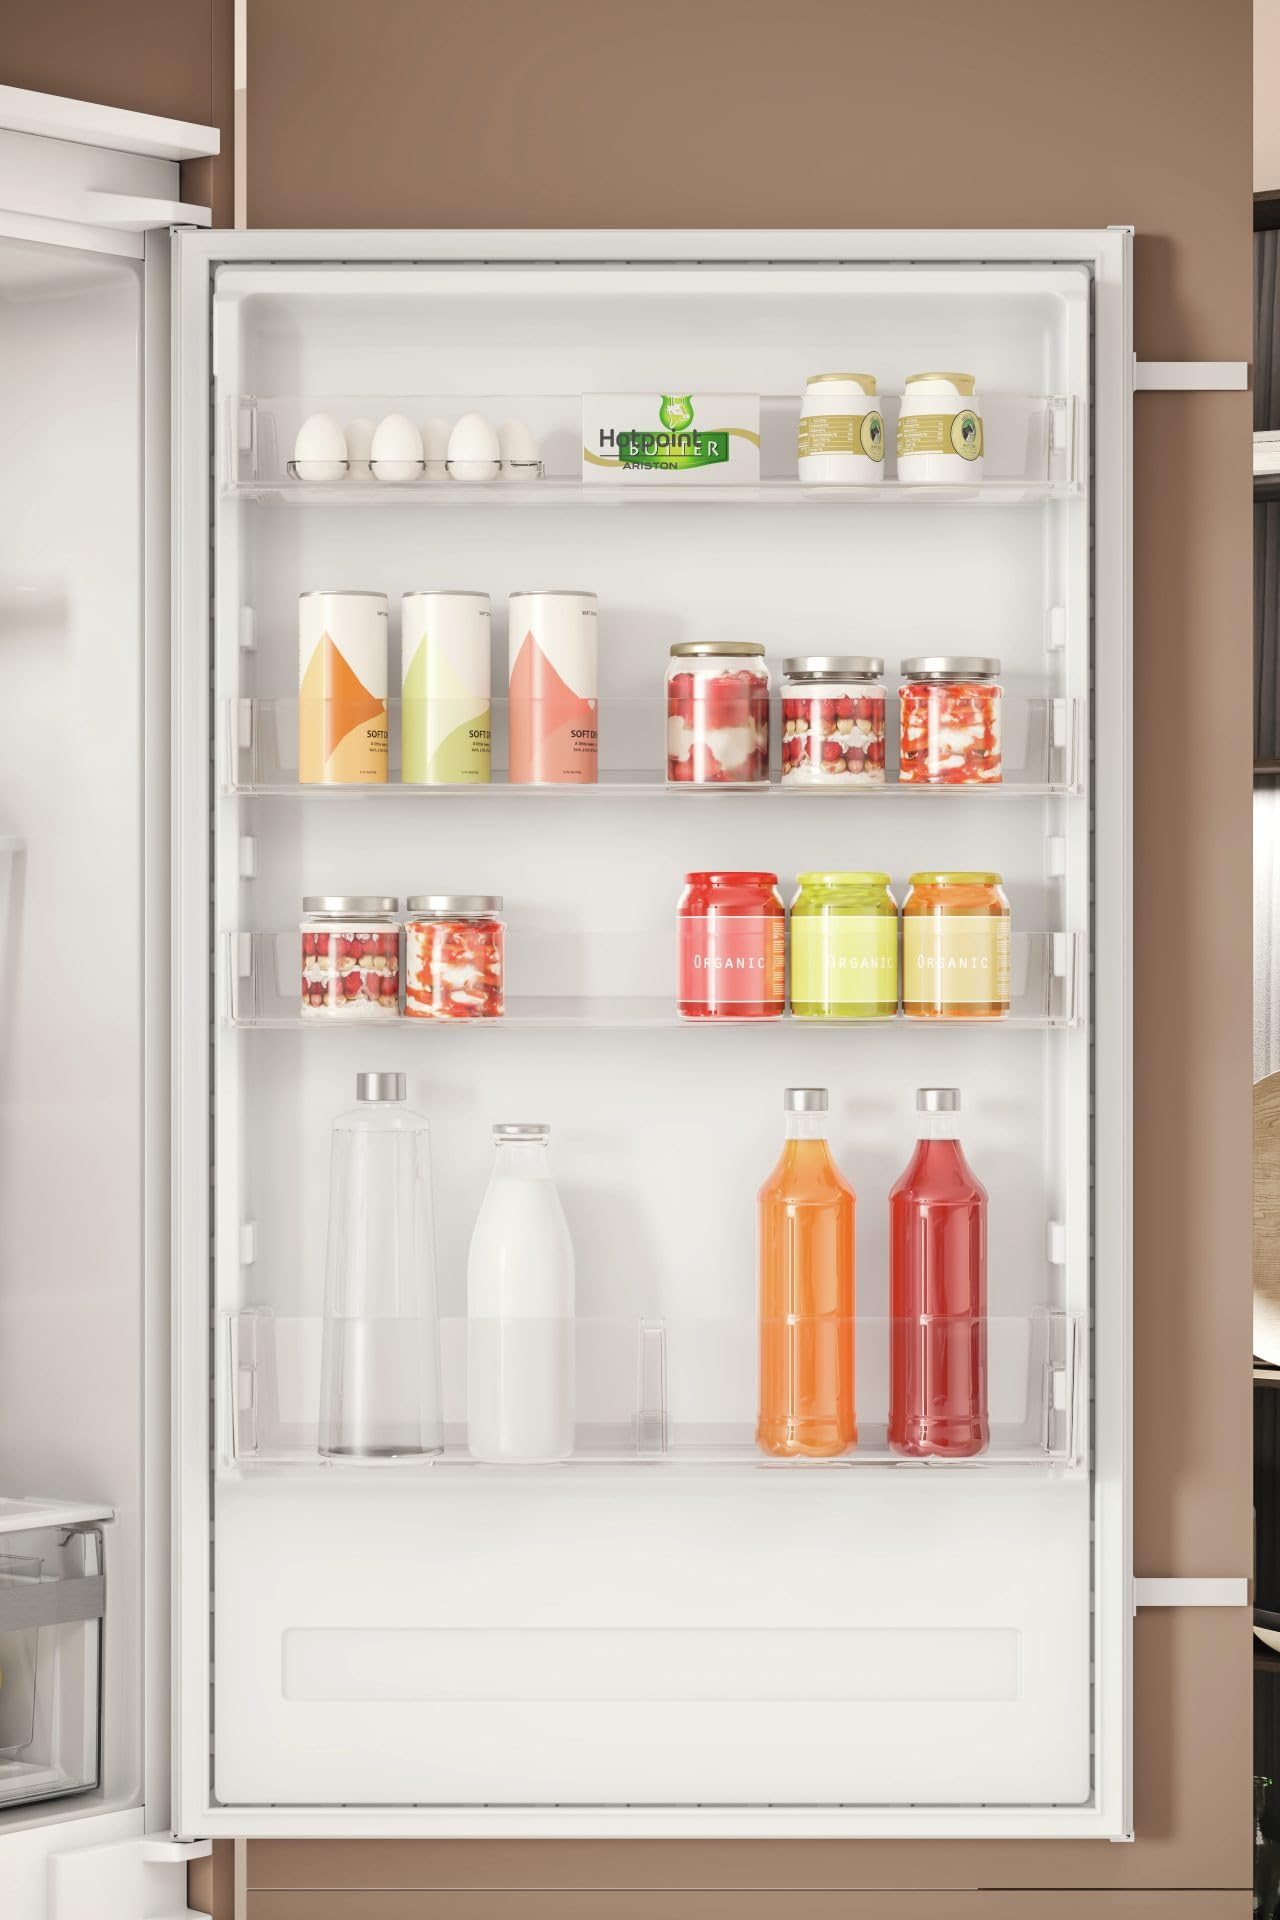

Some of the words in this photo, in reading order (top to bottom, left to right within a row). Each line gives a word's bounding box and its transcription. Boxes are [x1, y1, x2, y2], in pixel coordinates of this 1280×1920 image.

[599, 428, 703, 453] Hotpoint
[629, 440, 720, 457] BUTTER
[622, 462, 678, 470] ARISTON
[366, 729, 383, 739] SOFT
[468, 729, 486, 739] SOFT
[570, 729, 590, 739] SOFT
[694, 954, 766, 969] ORGANIC
[827, 955, 894, 969] ORGANIC
[917, 954, 989, 969] ORGANIC
